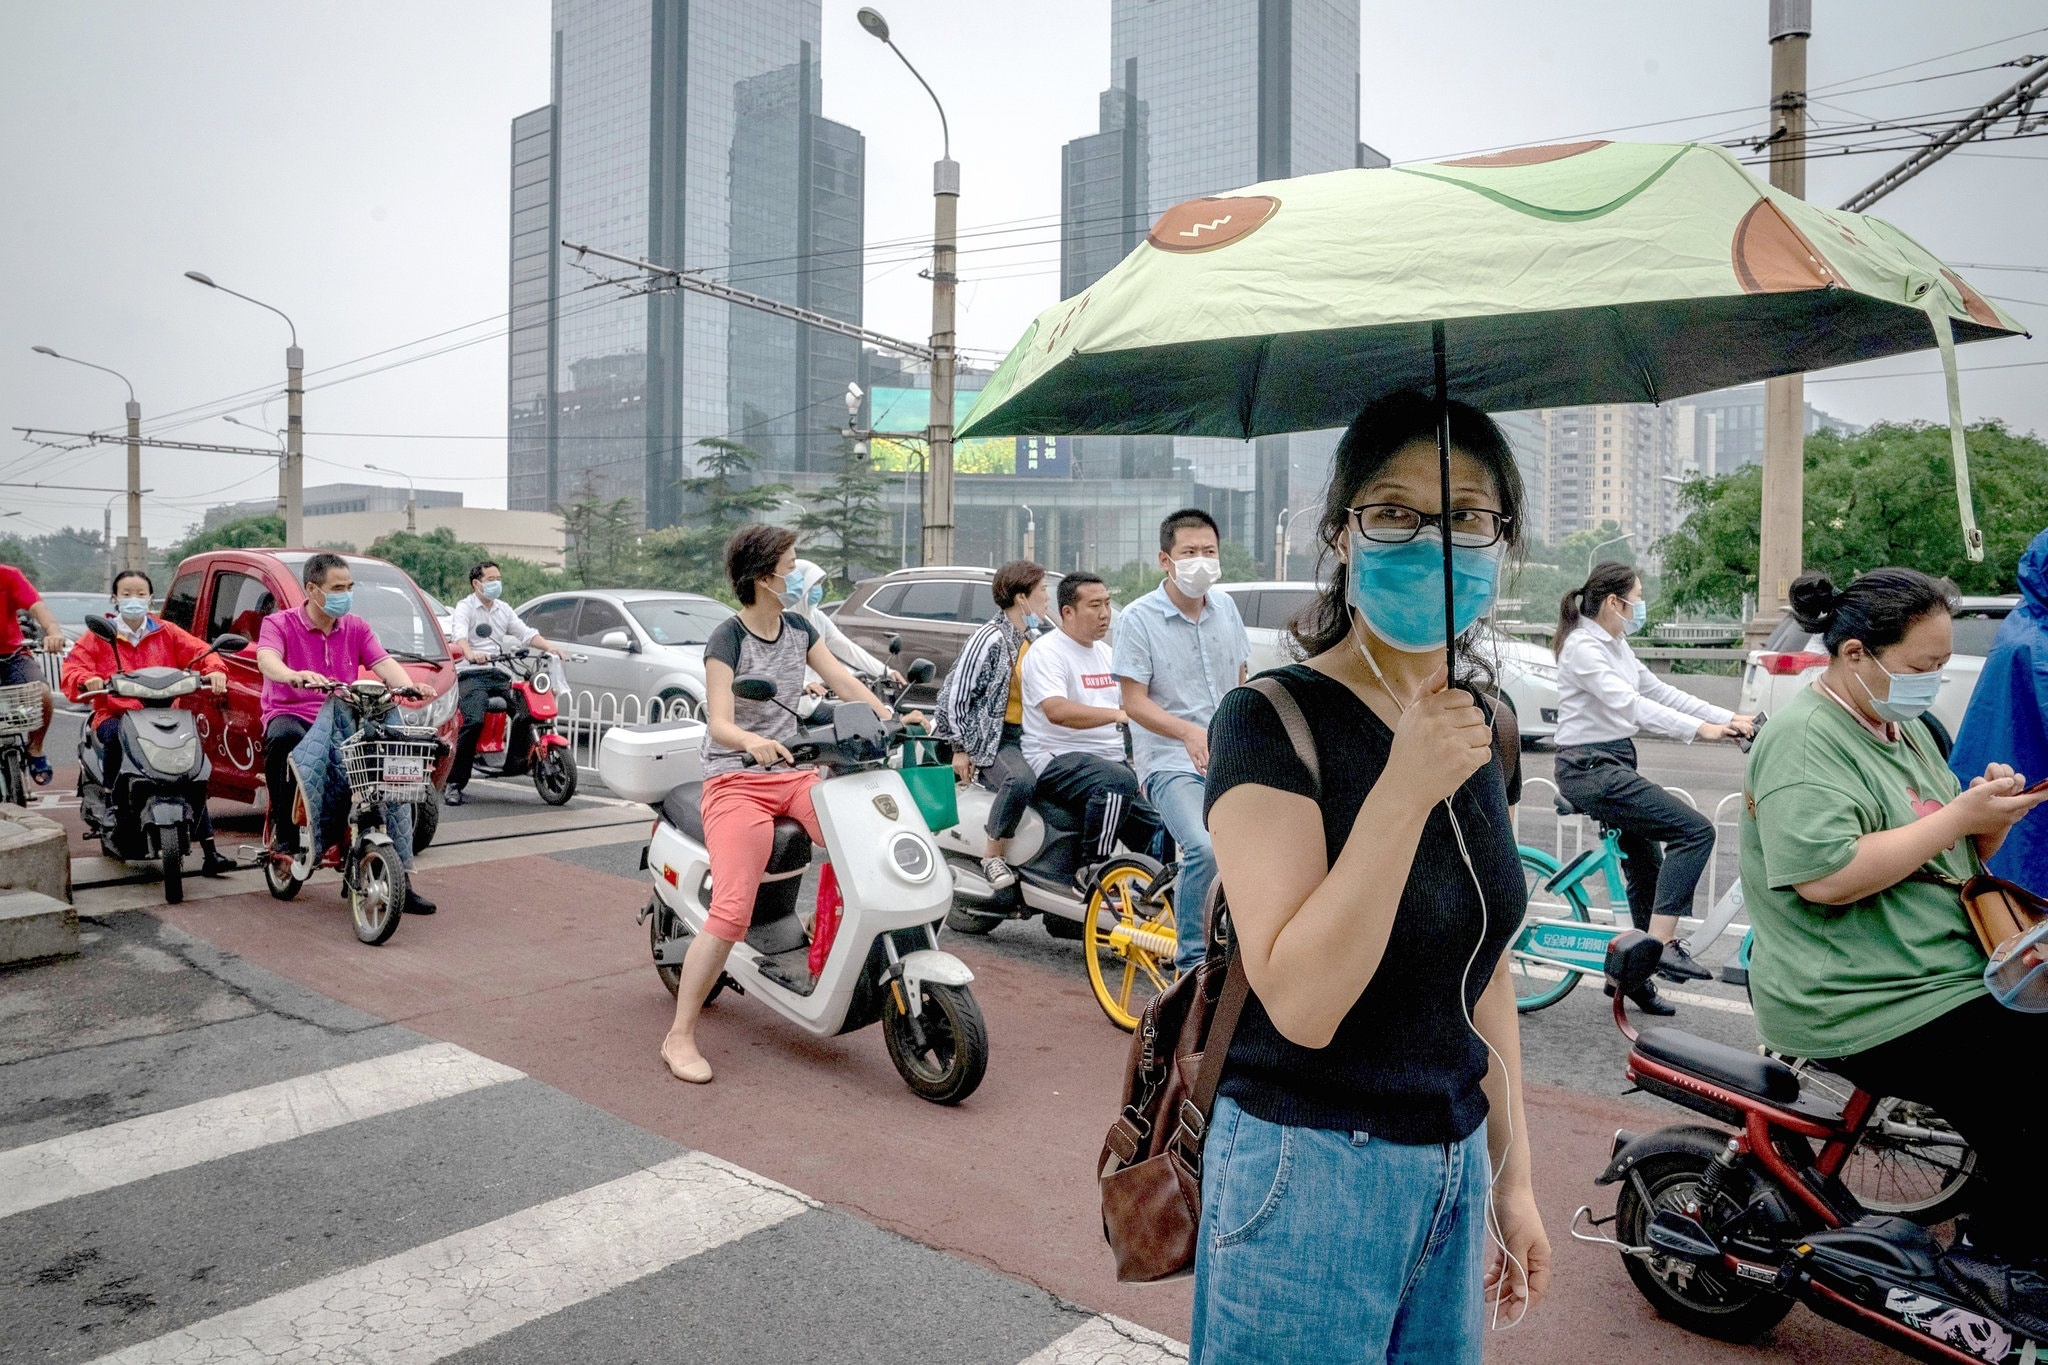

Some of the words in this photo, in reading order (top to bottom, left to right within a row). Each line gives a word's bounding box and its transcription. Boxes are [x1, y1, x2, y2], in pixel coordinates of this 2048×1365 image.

[388, 765, 420, 775] 富士达
[1673, 1076, 1701, 1090] SINCE
